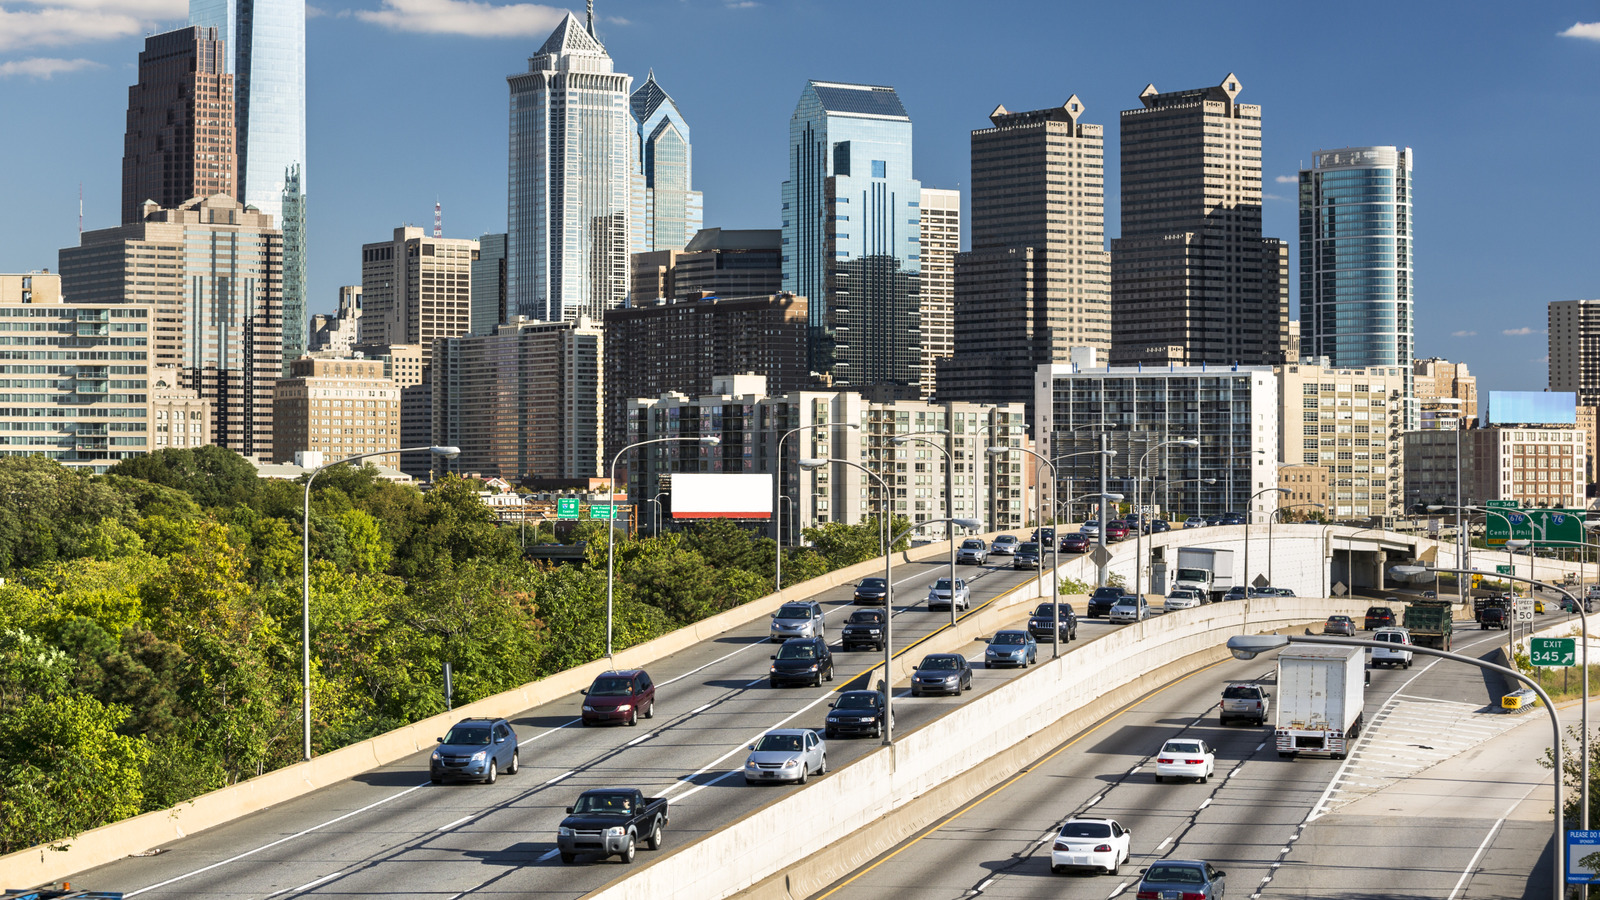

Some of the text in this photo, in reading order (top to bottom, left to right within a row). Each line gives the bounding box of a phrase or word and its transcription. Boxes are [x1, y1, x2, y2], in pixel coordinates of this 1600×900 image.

[1553, 515, 1564, 523] 76
[1519, 611, 1532, 620] 50
[1532, 651, 1559, 662] 345
